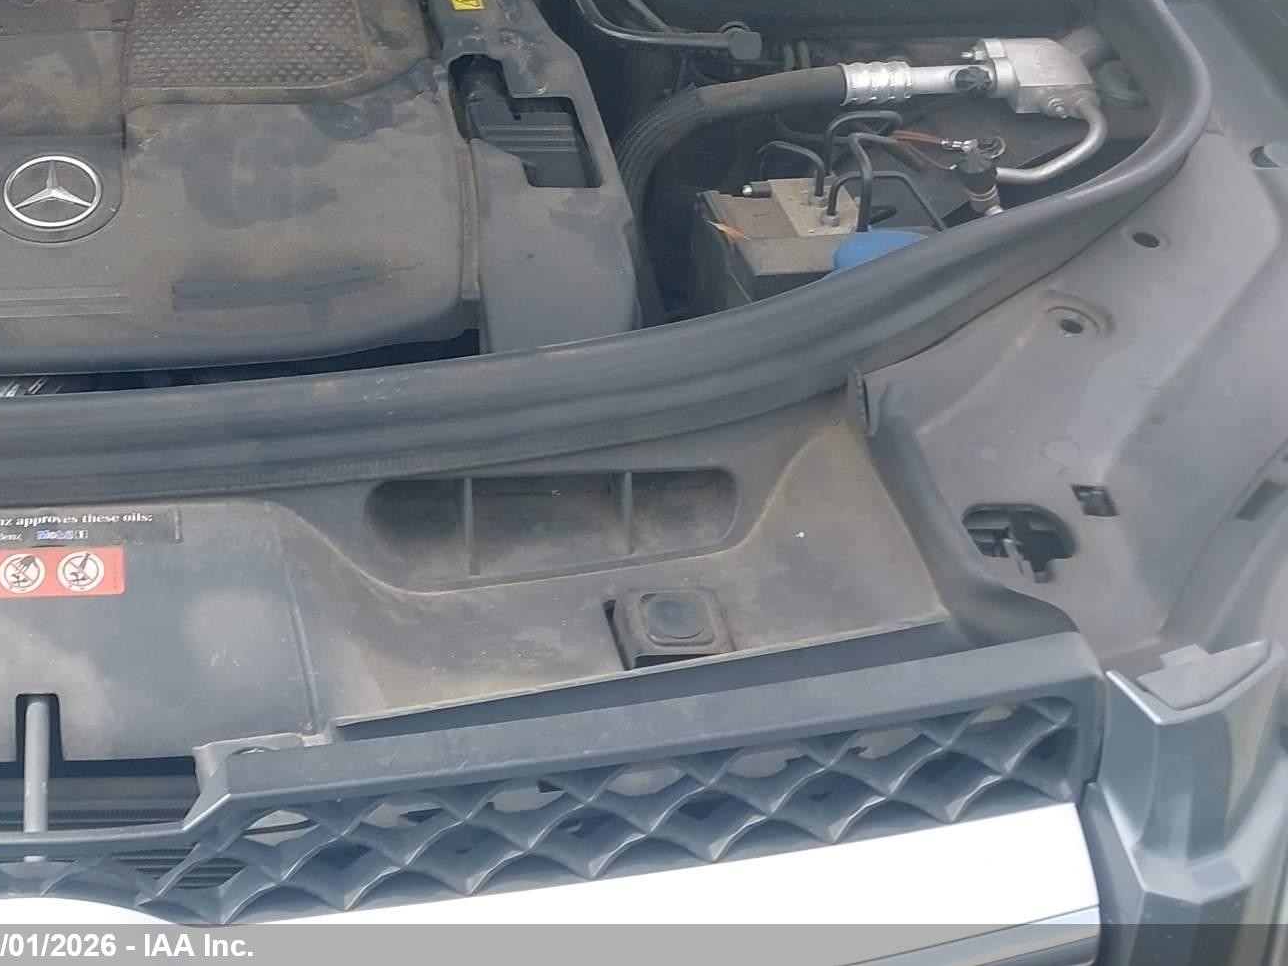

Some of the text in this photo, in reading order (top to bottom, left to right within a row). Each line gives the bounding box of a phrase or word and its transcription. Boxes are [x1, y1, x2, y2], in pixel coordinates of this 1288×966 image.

[15, 514, 79, 528] approves
[81, 513, 120, 523] these
[122, 512, 153, 523] oils:
